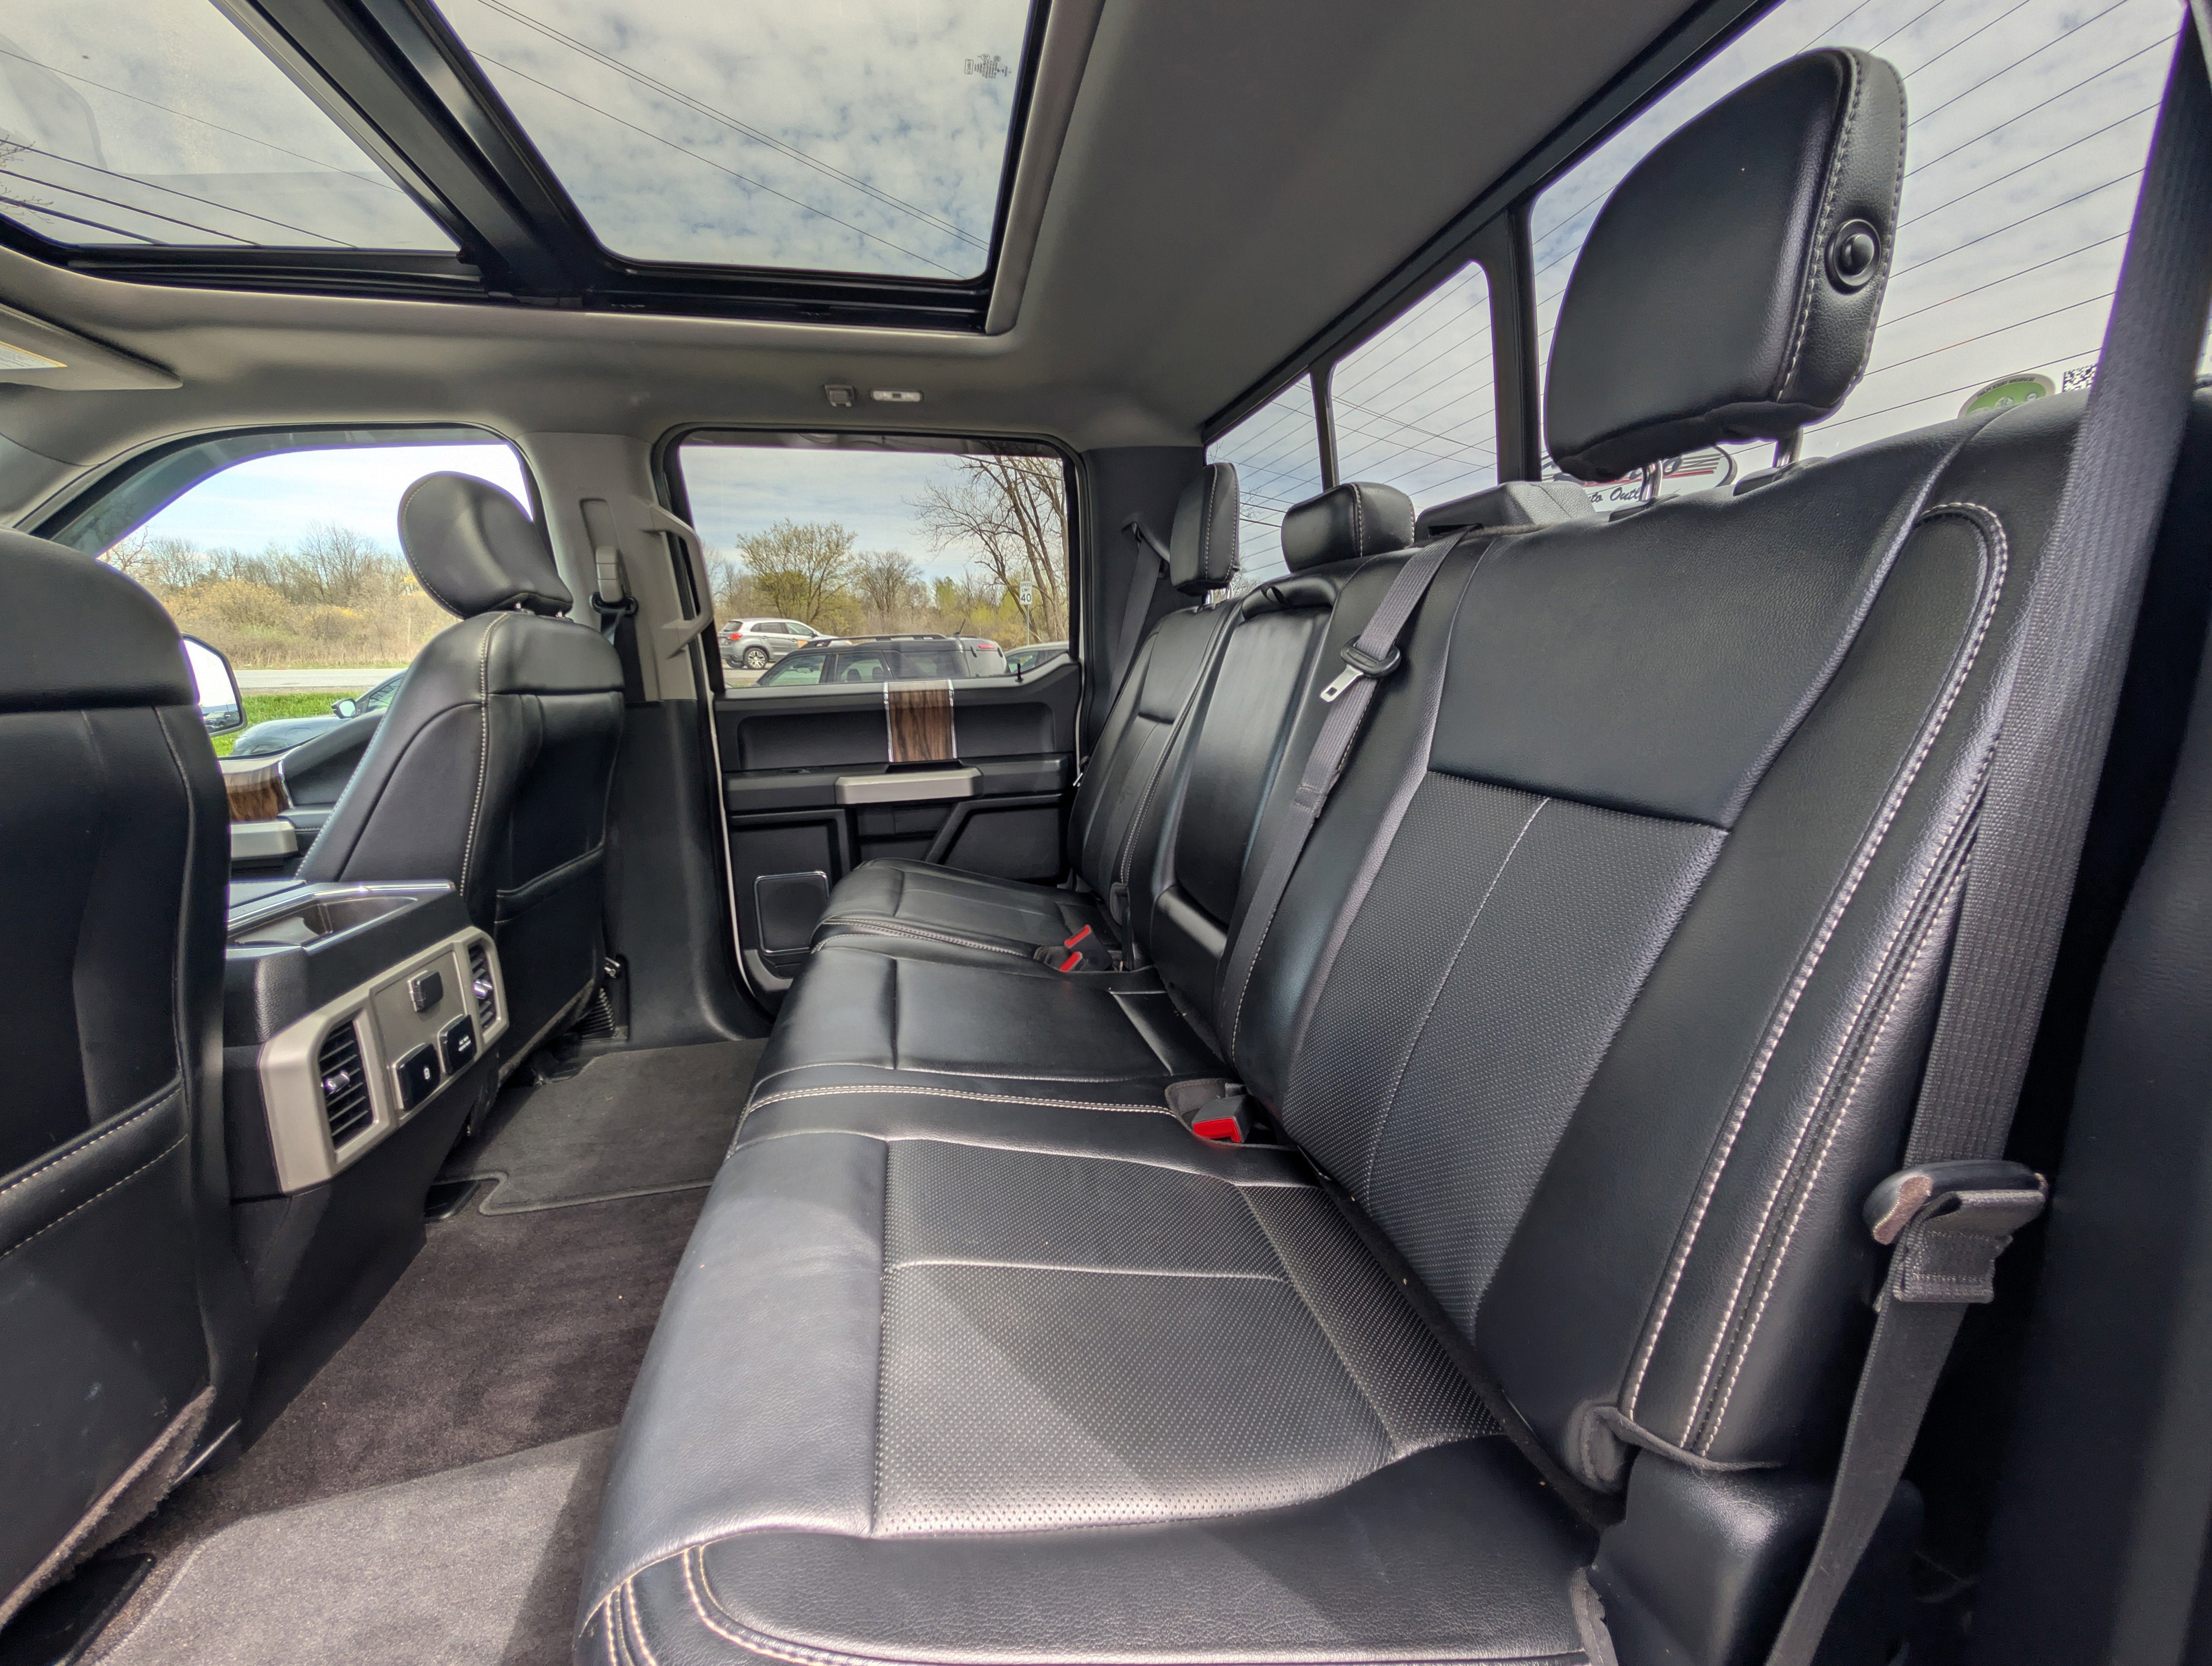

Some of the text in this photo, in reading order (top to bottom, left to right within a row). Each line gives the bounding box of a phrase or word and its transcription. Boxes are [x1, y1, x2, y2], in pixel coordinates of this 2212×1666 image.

[1589, 487, 1641, 502] to Outl
[1021, 593, 1031, 602] 40
